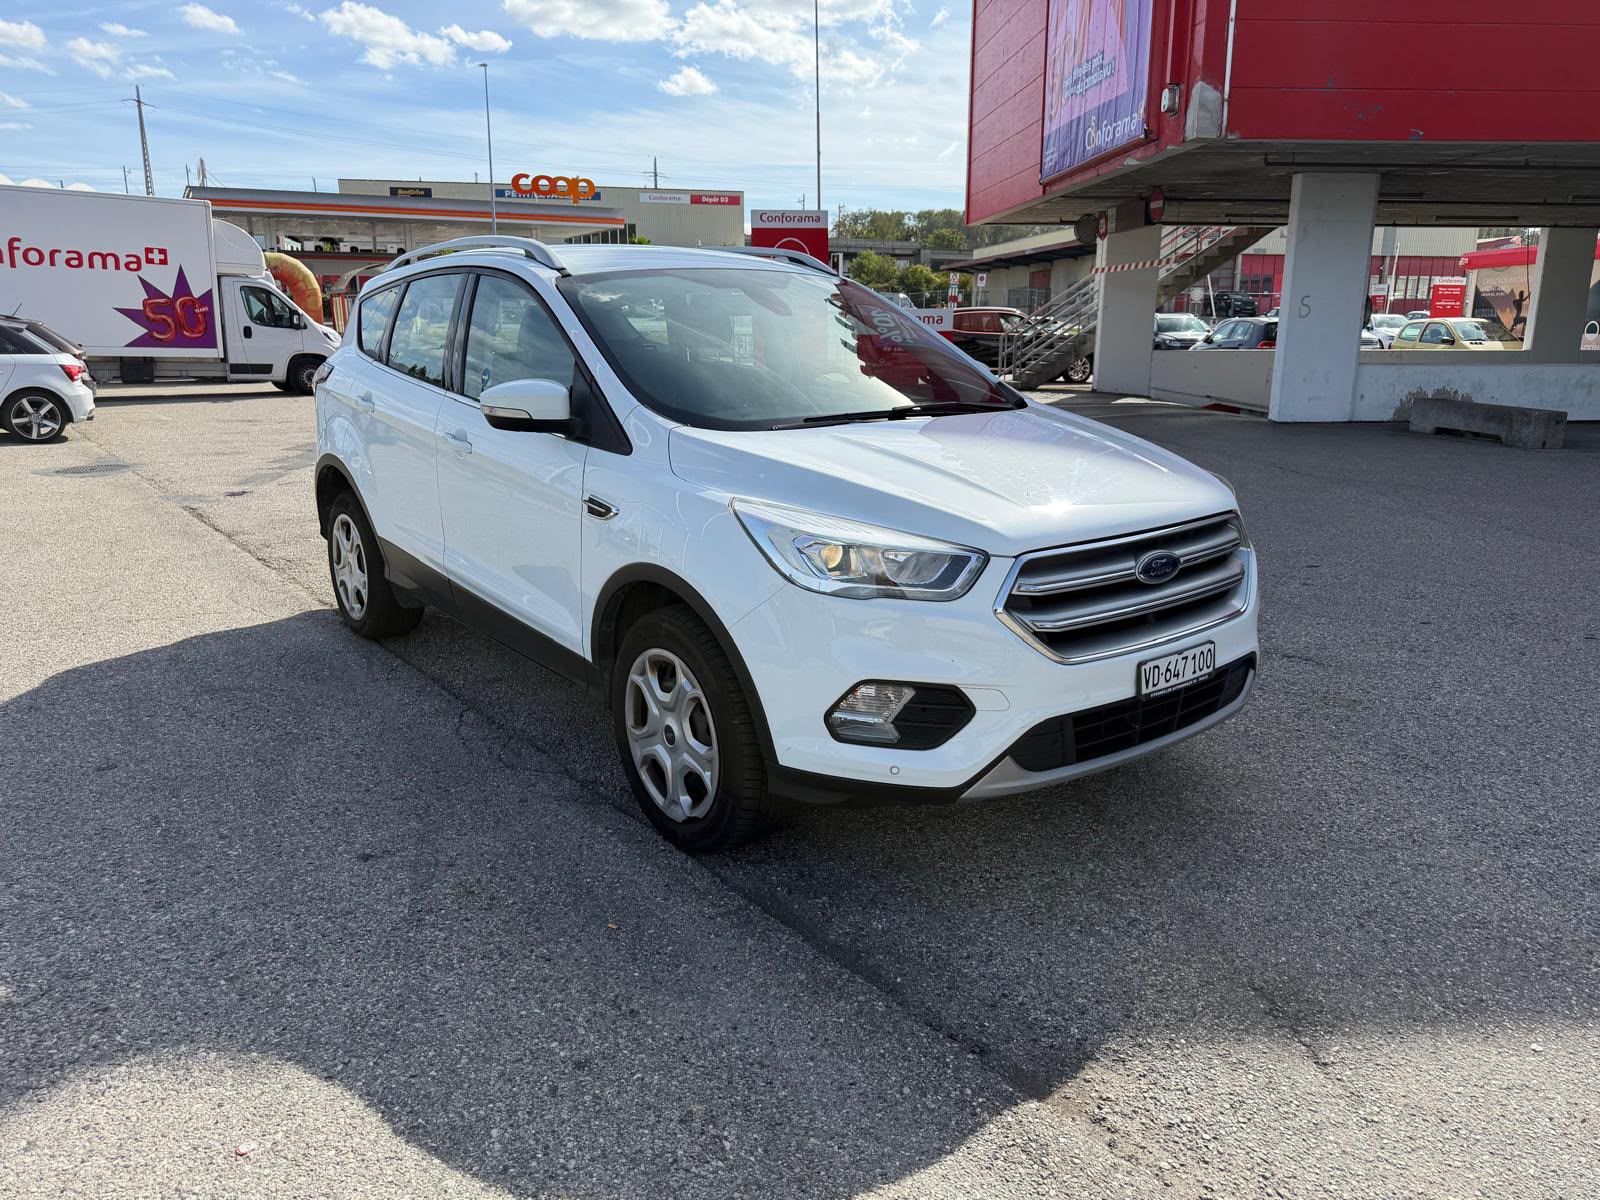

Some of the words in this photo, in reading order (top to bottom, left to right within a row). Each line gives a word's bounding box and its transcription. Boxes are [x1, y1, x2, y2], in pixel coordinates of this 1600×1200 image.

[1085, 112, 1138, 149] Conforama
[511, 173, 596, 204] coop
[648, 192, 681, 201] Conforama
[759, 212, 821, 225] Conforama
[0, 237, 142, 272] forama
[143, 296, 206, 341] 50
[1150, 558, 1171, 576] Ford
